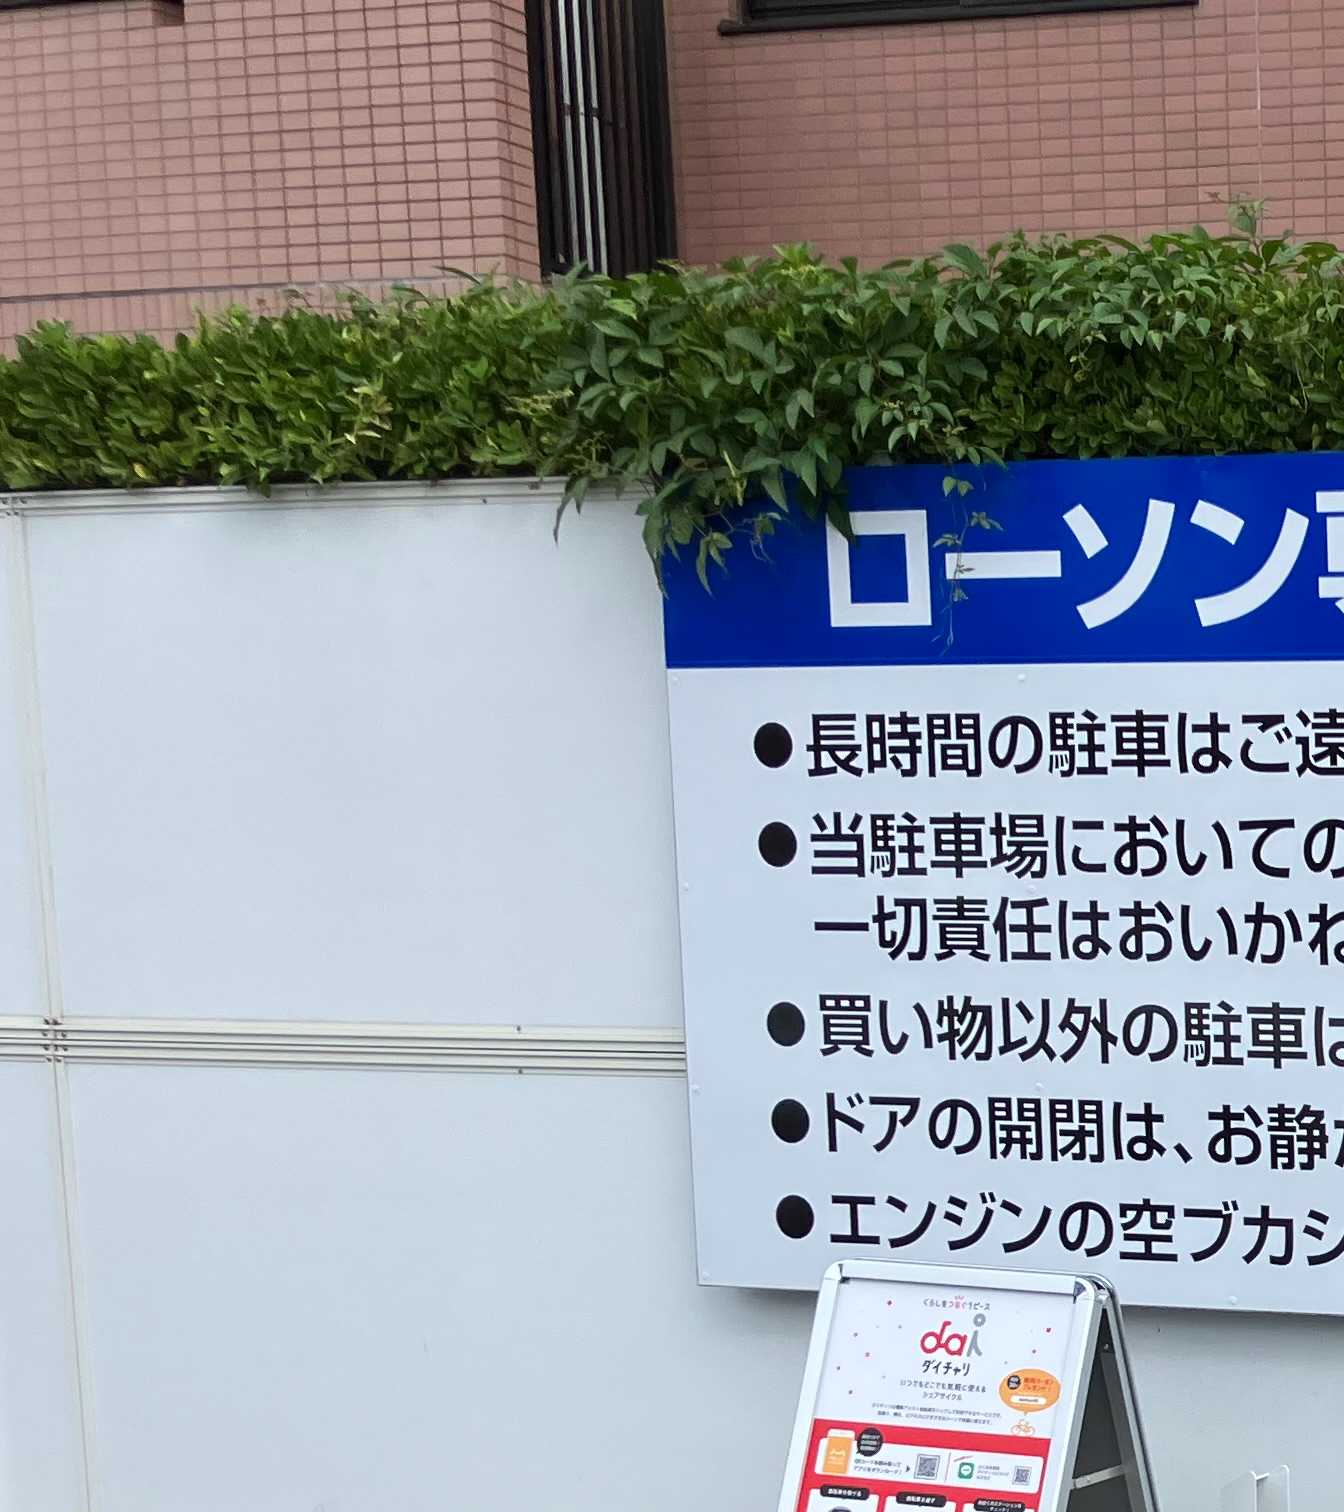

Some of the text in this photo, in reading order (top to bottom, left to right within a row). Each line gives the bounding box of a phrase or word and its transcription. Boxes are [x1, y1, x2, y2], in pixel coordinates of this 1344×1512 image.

[922, 1359, 971, 1377] ダイチャリ
